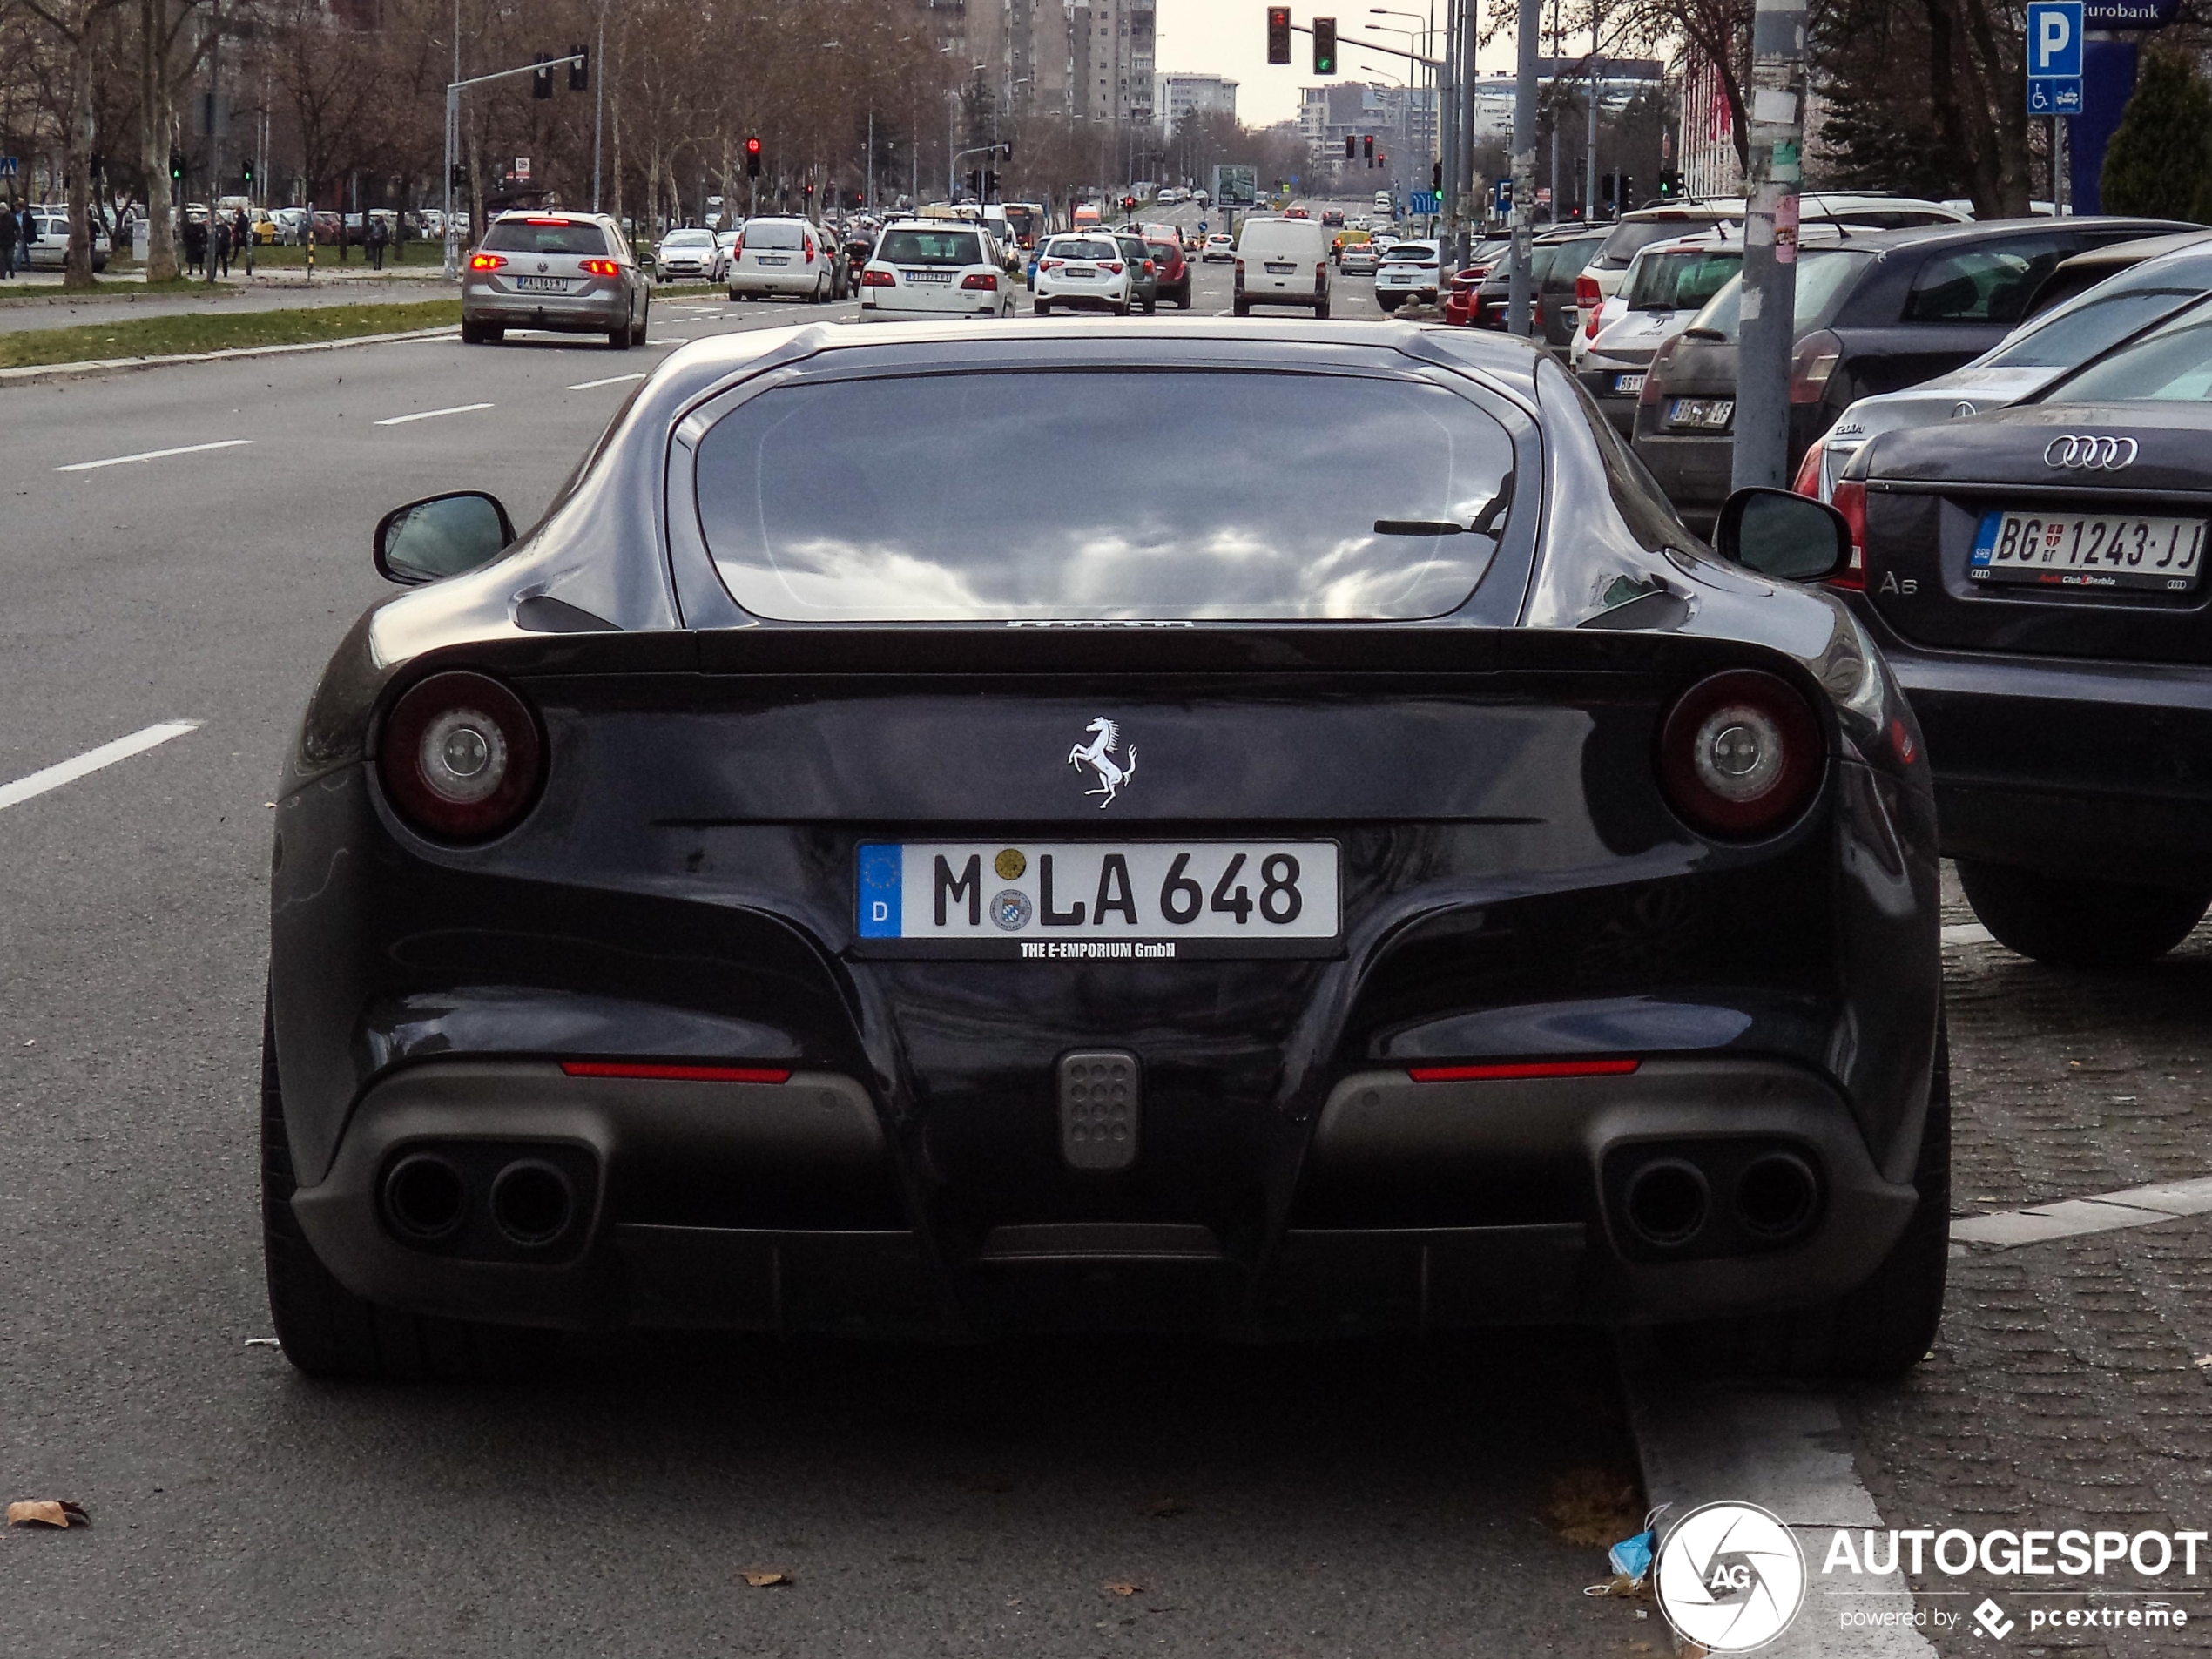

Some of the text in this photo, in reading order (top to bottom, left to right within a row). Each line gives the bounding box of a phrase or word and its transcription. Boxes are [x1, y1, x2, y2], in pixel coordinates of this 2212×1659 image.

[2040, 11, 2070, 68] P
[1621, 375, 1633, 390] BG
[1997, 517, 2042, 561] BG
[1974, 548, 1992, 559] SRB
[1878, 570, 1919, 595] A6
[2062, 575, 2082, 585] Club
[2084, 576, 2116, 586] Serbia
[934, 853, 981, 926] M
[1039, 853, 1138, 926] LA
[1161, 853, 1302, 926] 648
[872, 900, 888, 922] D
[1020, 942, 1176, 958] THE E-EMPORIUM GmbH
